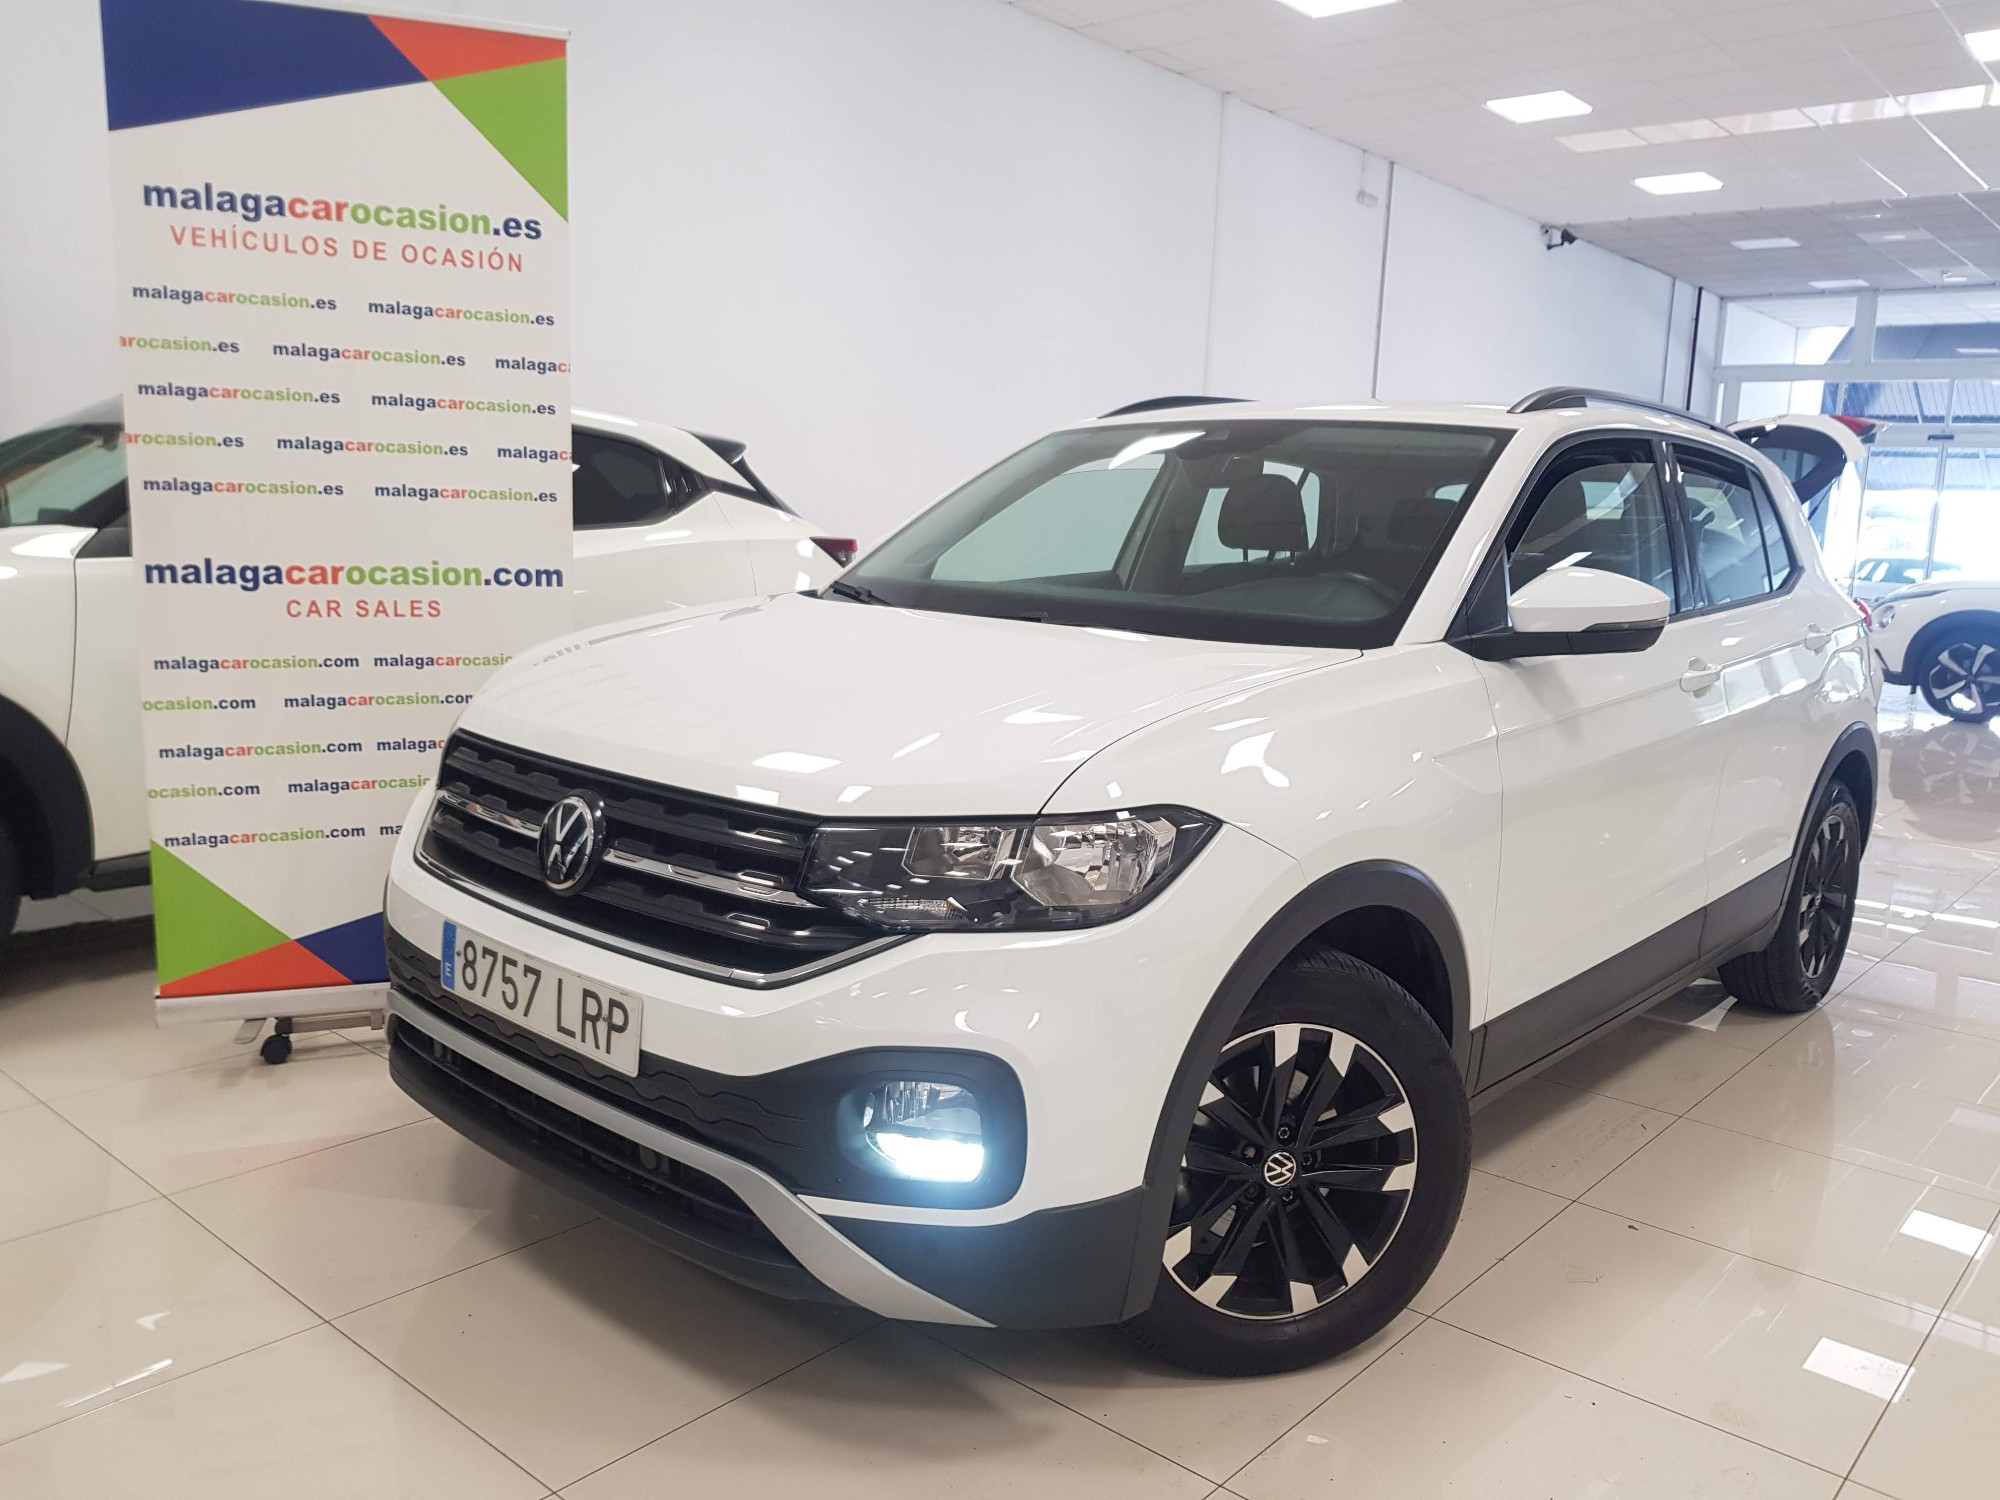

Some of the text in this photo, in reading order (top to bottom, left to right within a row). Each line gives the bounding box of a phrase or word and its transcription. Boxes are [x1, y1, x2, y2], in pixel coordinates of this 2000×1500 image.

[144, 182, 543, 240] malagacarocasion.es
[171, 223, 522, 272] VEHÍCULOS DE OCASIÓN
[133, 285, 337, 310] malagacarocasion.es
[369, 301, 554, 325] malagacarocasion.es
[273, 343, 465, 366] malagacarocasion.es
[496, 355, 571, 375] malagac
[138, 382, 340, 403] malagacarocasion.es
[372, 393, 556, 415] malagacarocasion.es
[277, 436, 468, 456] malagacarocasion.es
[144, 477, 343, 495] malagacarocasion.es
[375, 484, 557, 502] malagacarocasion.es
[145, 558, 563, 592] malagacarocasion.com
[287, 600, 441, 618] CAR SALES
[154, 656, 359, 672] malagacarocasion.com
[159, 743, 362, 760] malagacarocasion.com
[165, 827, 365, 848] malagacarocasion.com
[463, 940, 629, 1054] 8757 LRP
